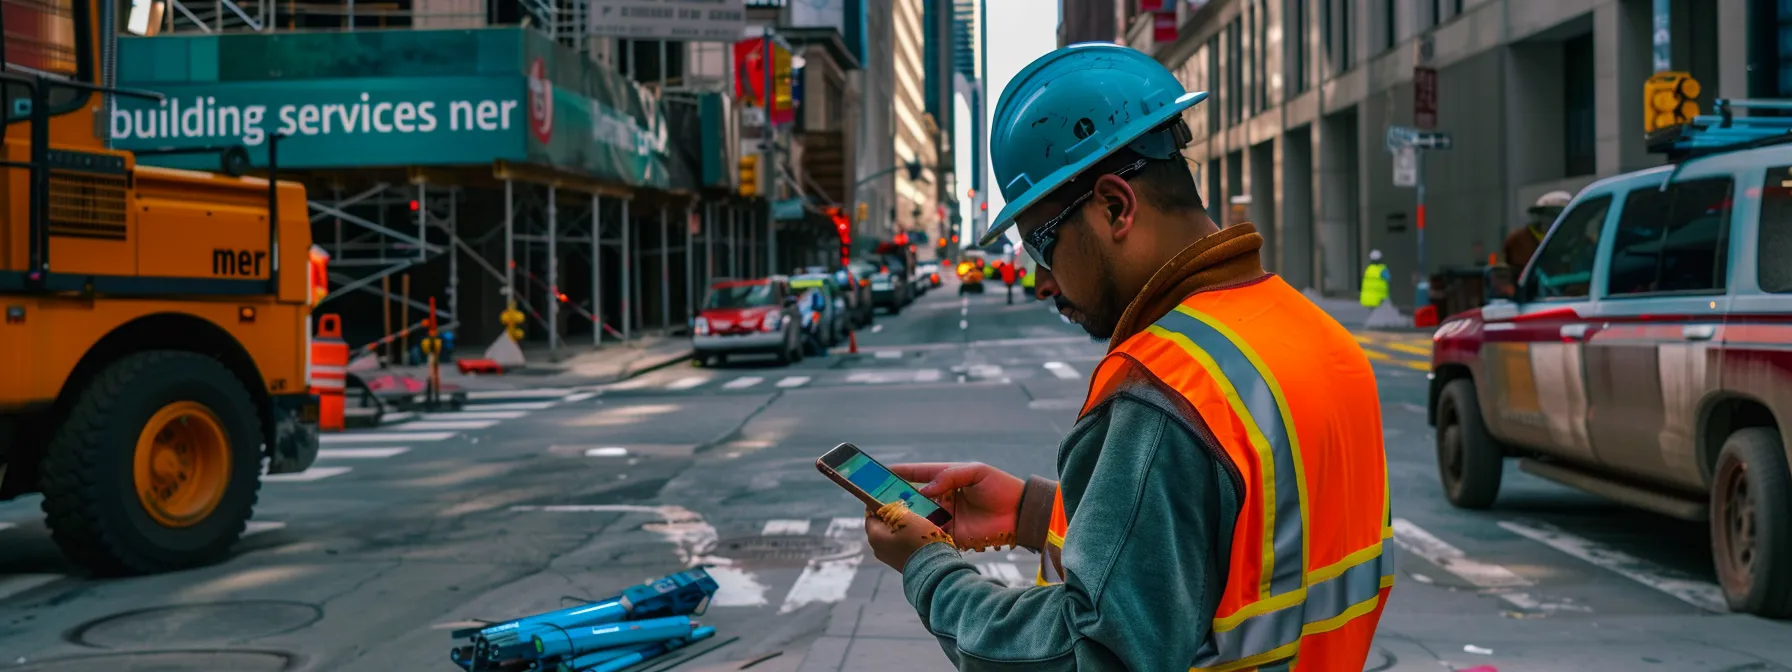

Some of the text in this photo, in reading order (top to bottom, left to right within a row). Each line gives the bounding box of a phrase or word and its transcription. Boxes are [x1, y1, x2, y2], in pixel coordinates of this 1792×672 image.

[111, 96, 266, 146] building
[277, 92, 437, 136] services
[449, 99, 518, 131] ner
[212, 247, 266, 276] mer
